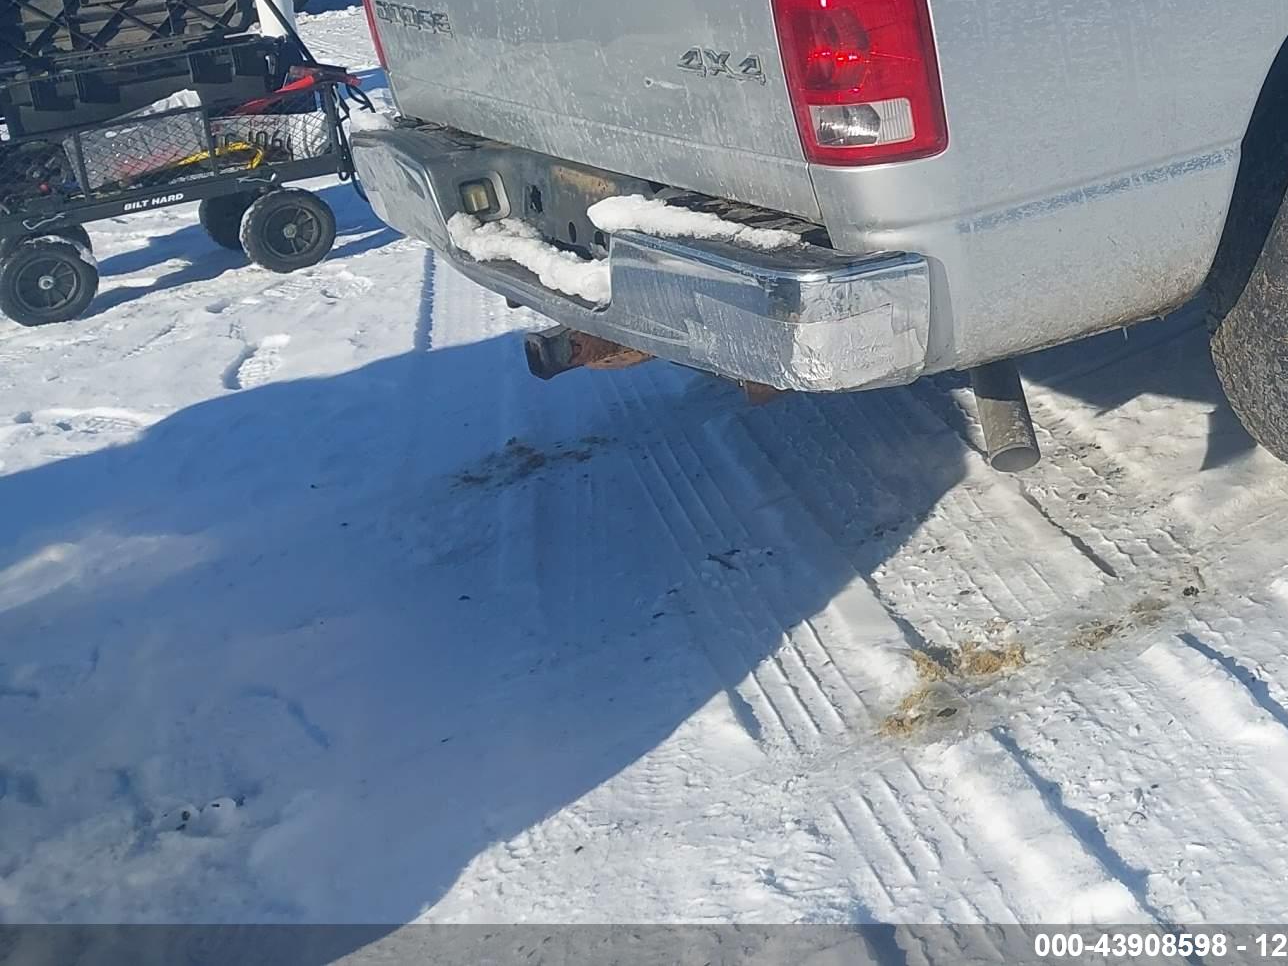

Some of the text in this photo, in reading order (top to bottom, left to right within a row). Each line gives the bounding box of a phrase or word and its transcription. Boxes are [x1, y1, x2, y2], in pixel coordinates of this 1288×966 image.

[375, 0, 454, 38] DODGE
[124, 193, 184, 211] BILT HARD
